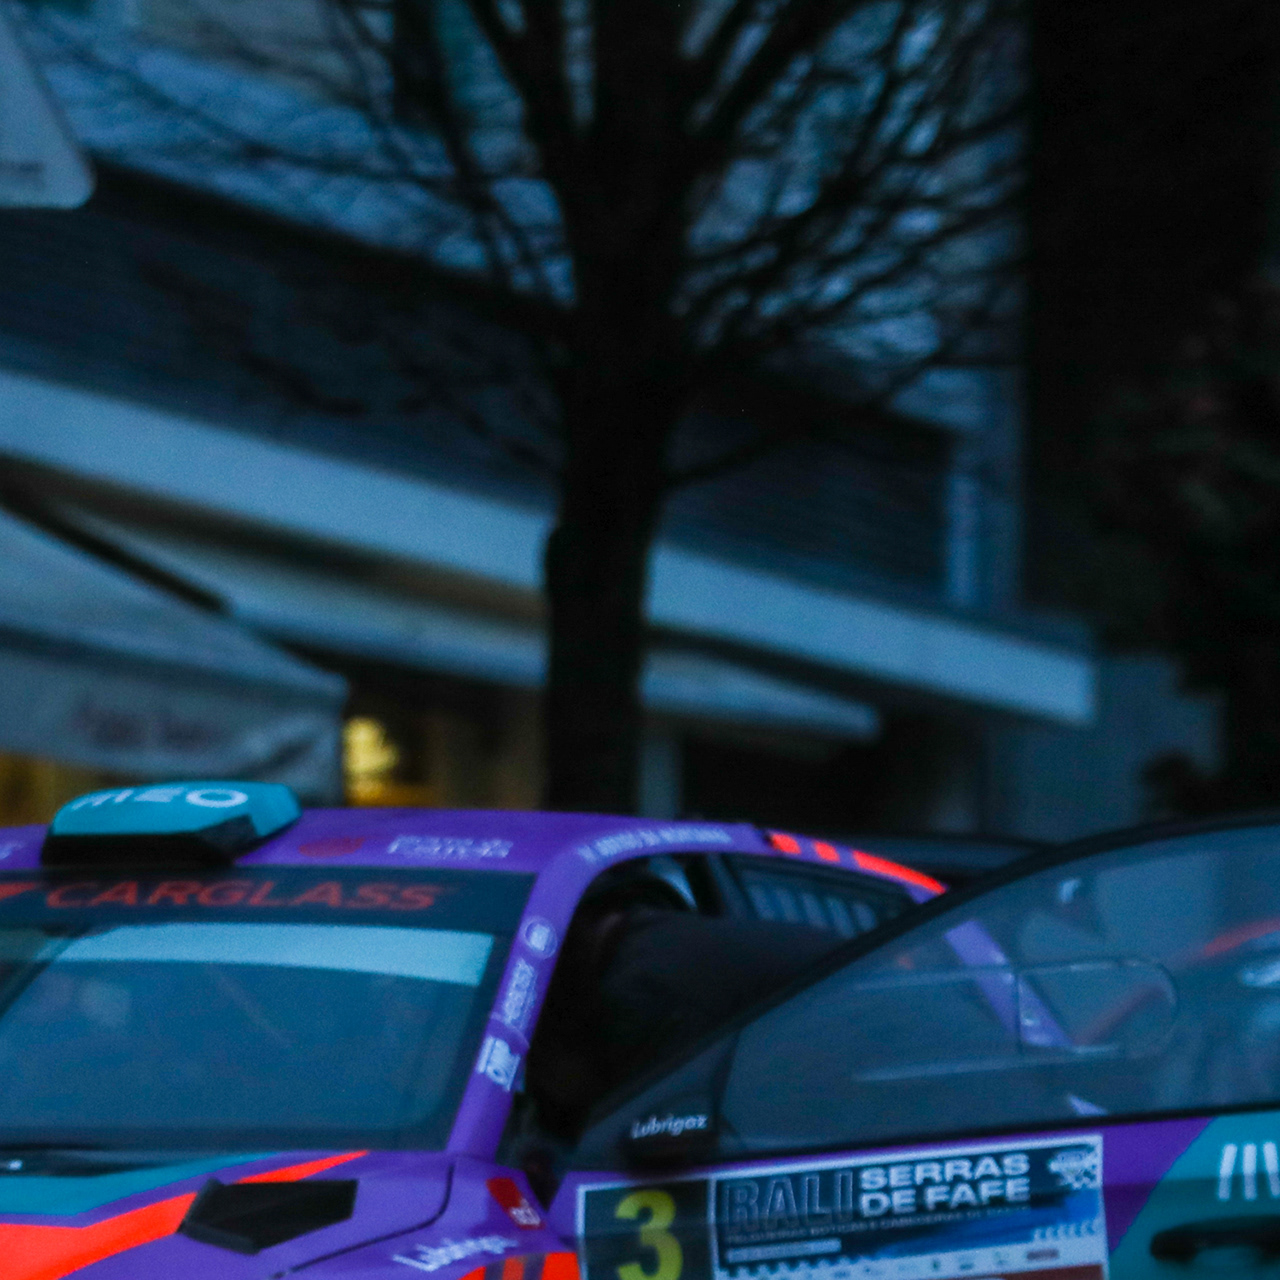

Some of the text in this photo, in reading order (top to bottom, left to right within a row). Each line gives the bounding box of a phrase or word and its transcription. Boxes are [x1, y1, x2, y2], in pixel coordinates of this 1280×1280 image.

[44, 881, 444, 910] CARGLASS
[858, 1153, 1031, 1190] SERRAS
[723, 1169, 855, 1236] RALI
[859, 1177, 1031, 1219] DE FAFE
